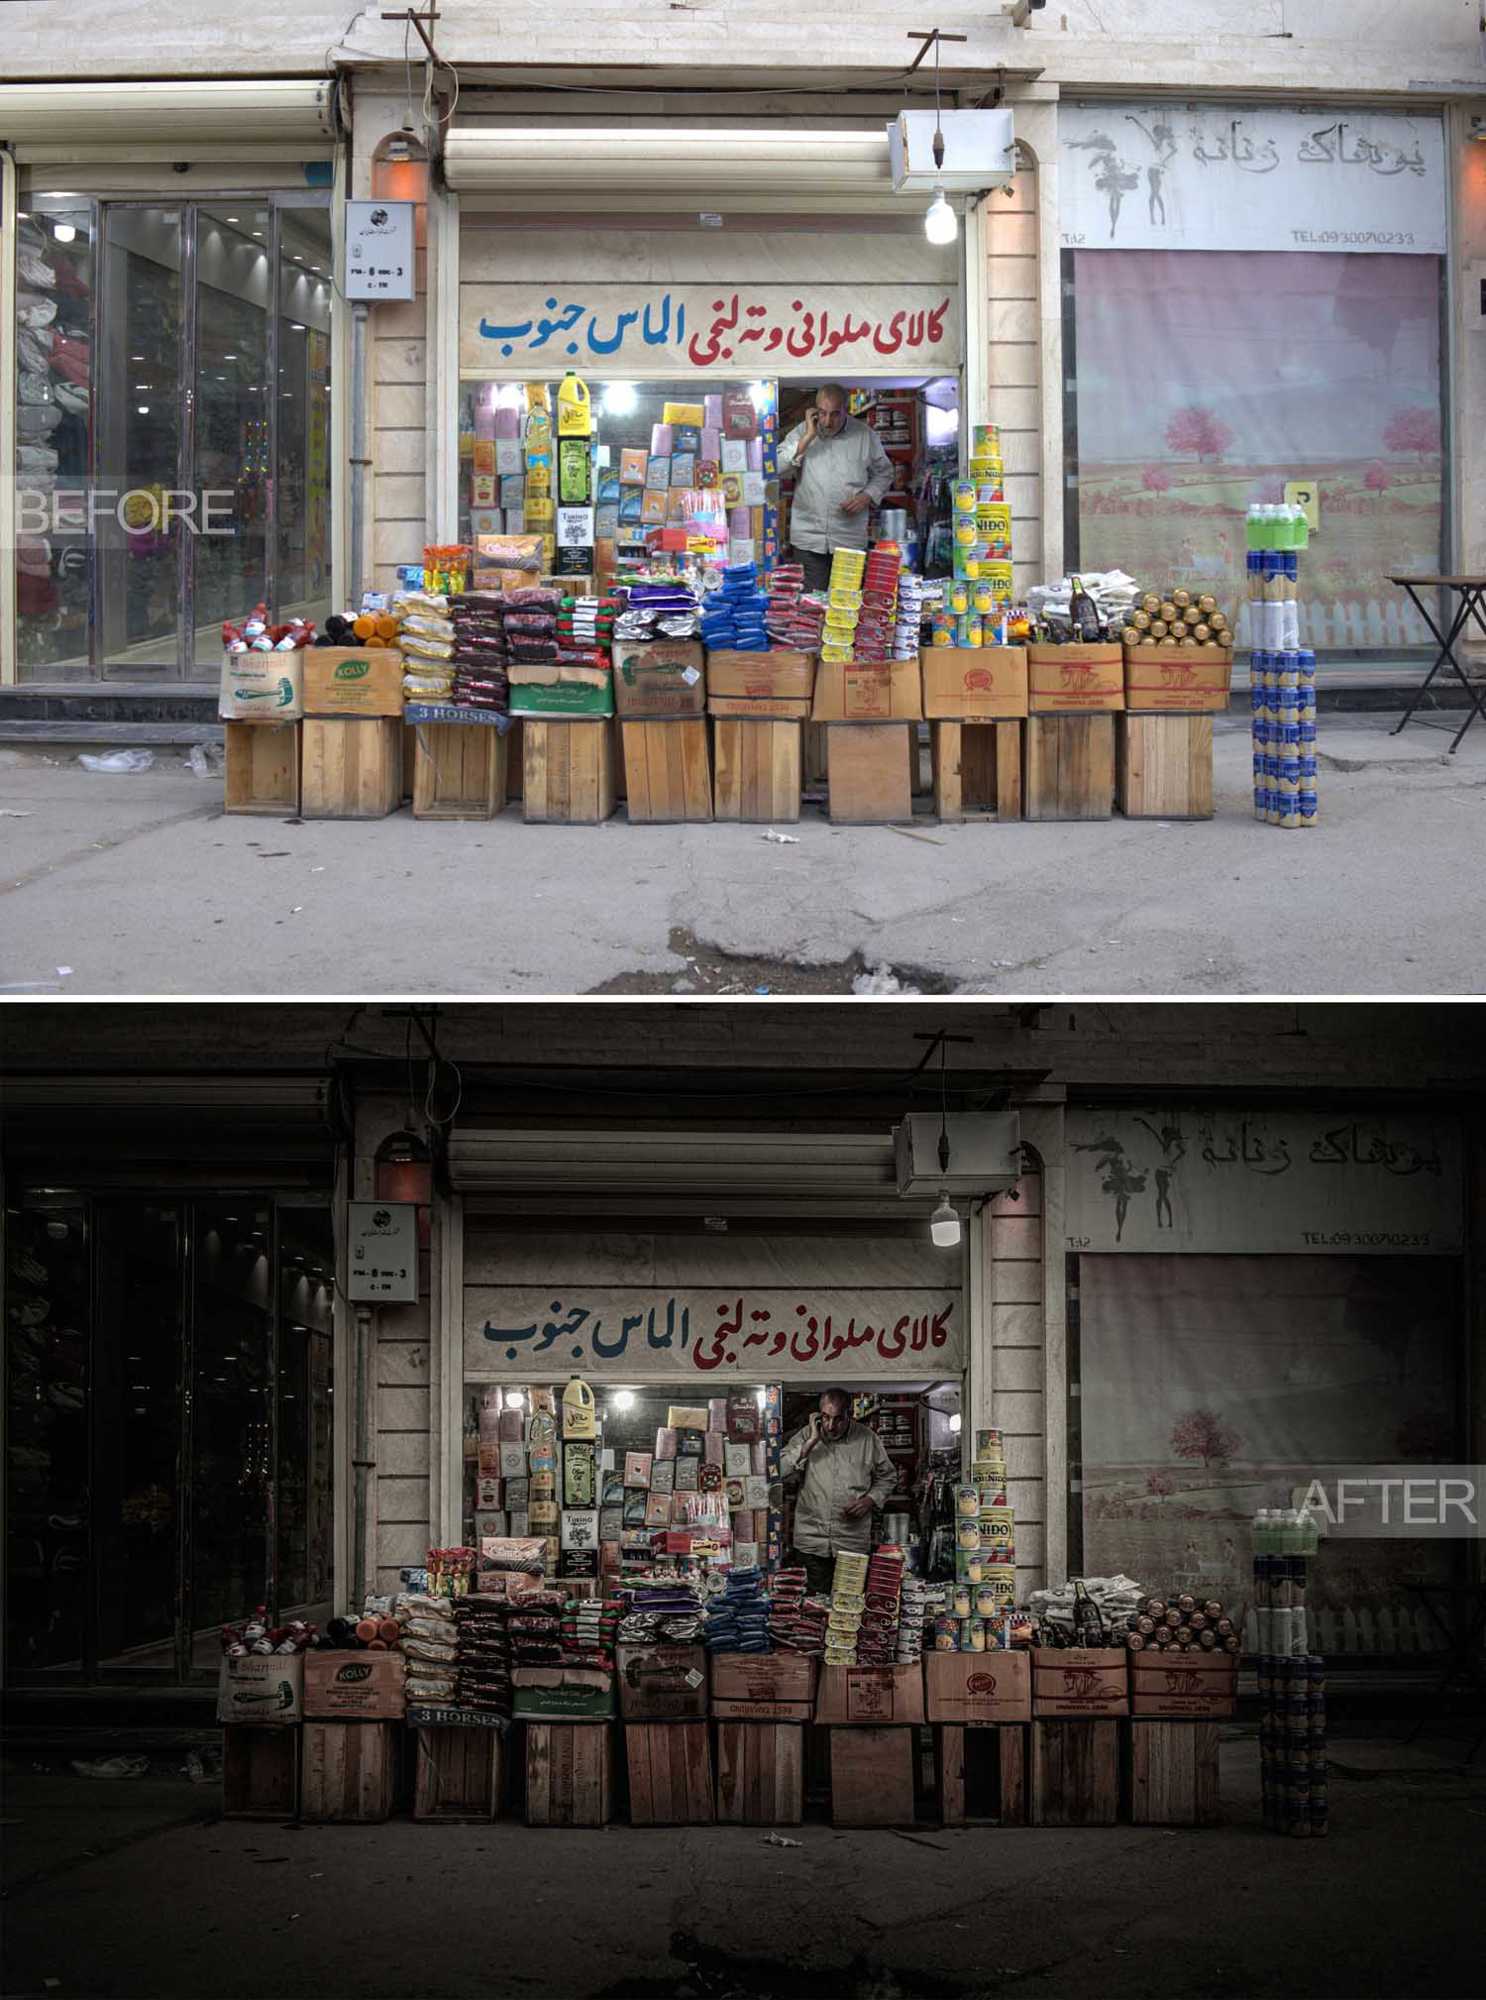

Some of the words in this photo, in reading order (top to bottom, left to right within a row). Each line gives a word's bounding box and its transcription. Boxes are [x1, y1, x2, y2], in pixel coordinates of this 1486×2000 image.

[1297, 121, 1427, 177] پوشاک
[479, 297, 587, 357] جنوب
[587, 293, 685, 354] الماس
[786, 299, 871, 358] ملوانی
[872, 297, 951, 355] کالای
[992, 579, 1011, 590] IDO
[419, 706, 429, 719] 3
[433, 707, 498, 723] HORSES
[483, 1300, 590, 1360] جنوب
[591, 1297, 689, 1359] الماس
[790, 1304, 875, 1362] ملوانی
[876, 1302, 954, 1359] کالای
[996, 1583, 1014, 1594] IDO
[421, 1709, 432, 1721] 3
[436, 1711, 501, 1728] HORSES
